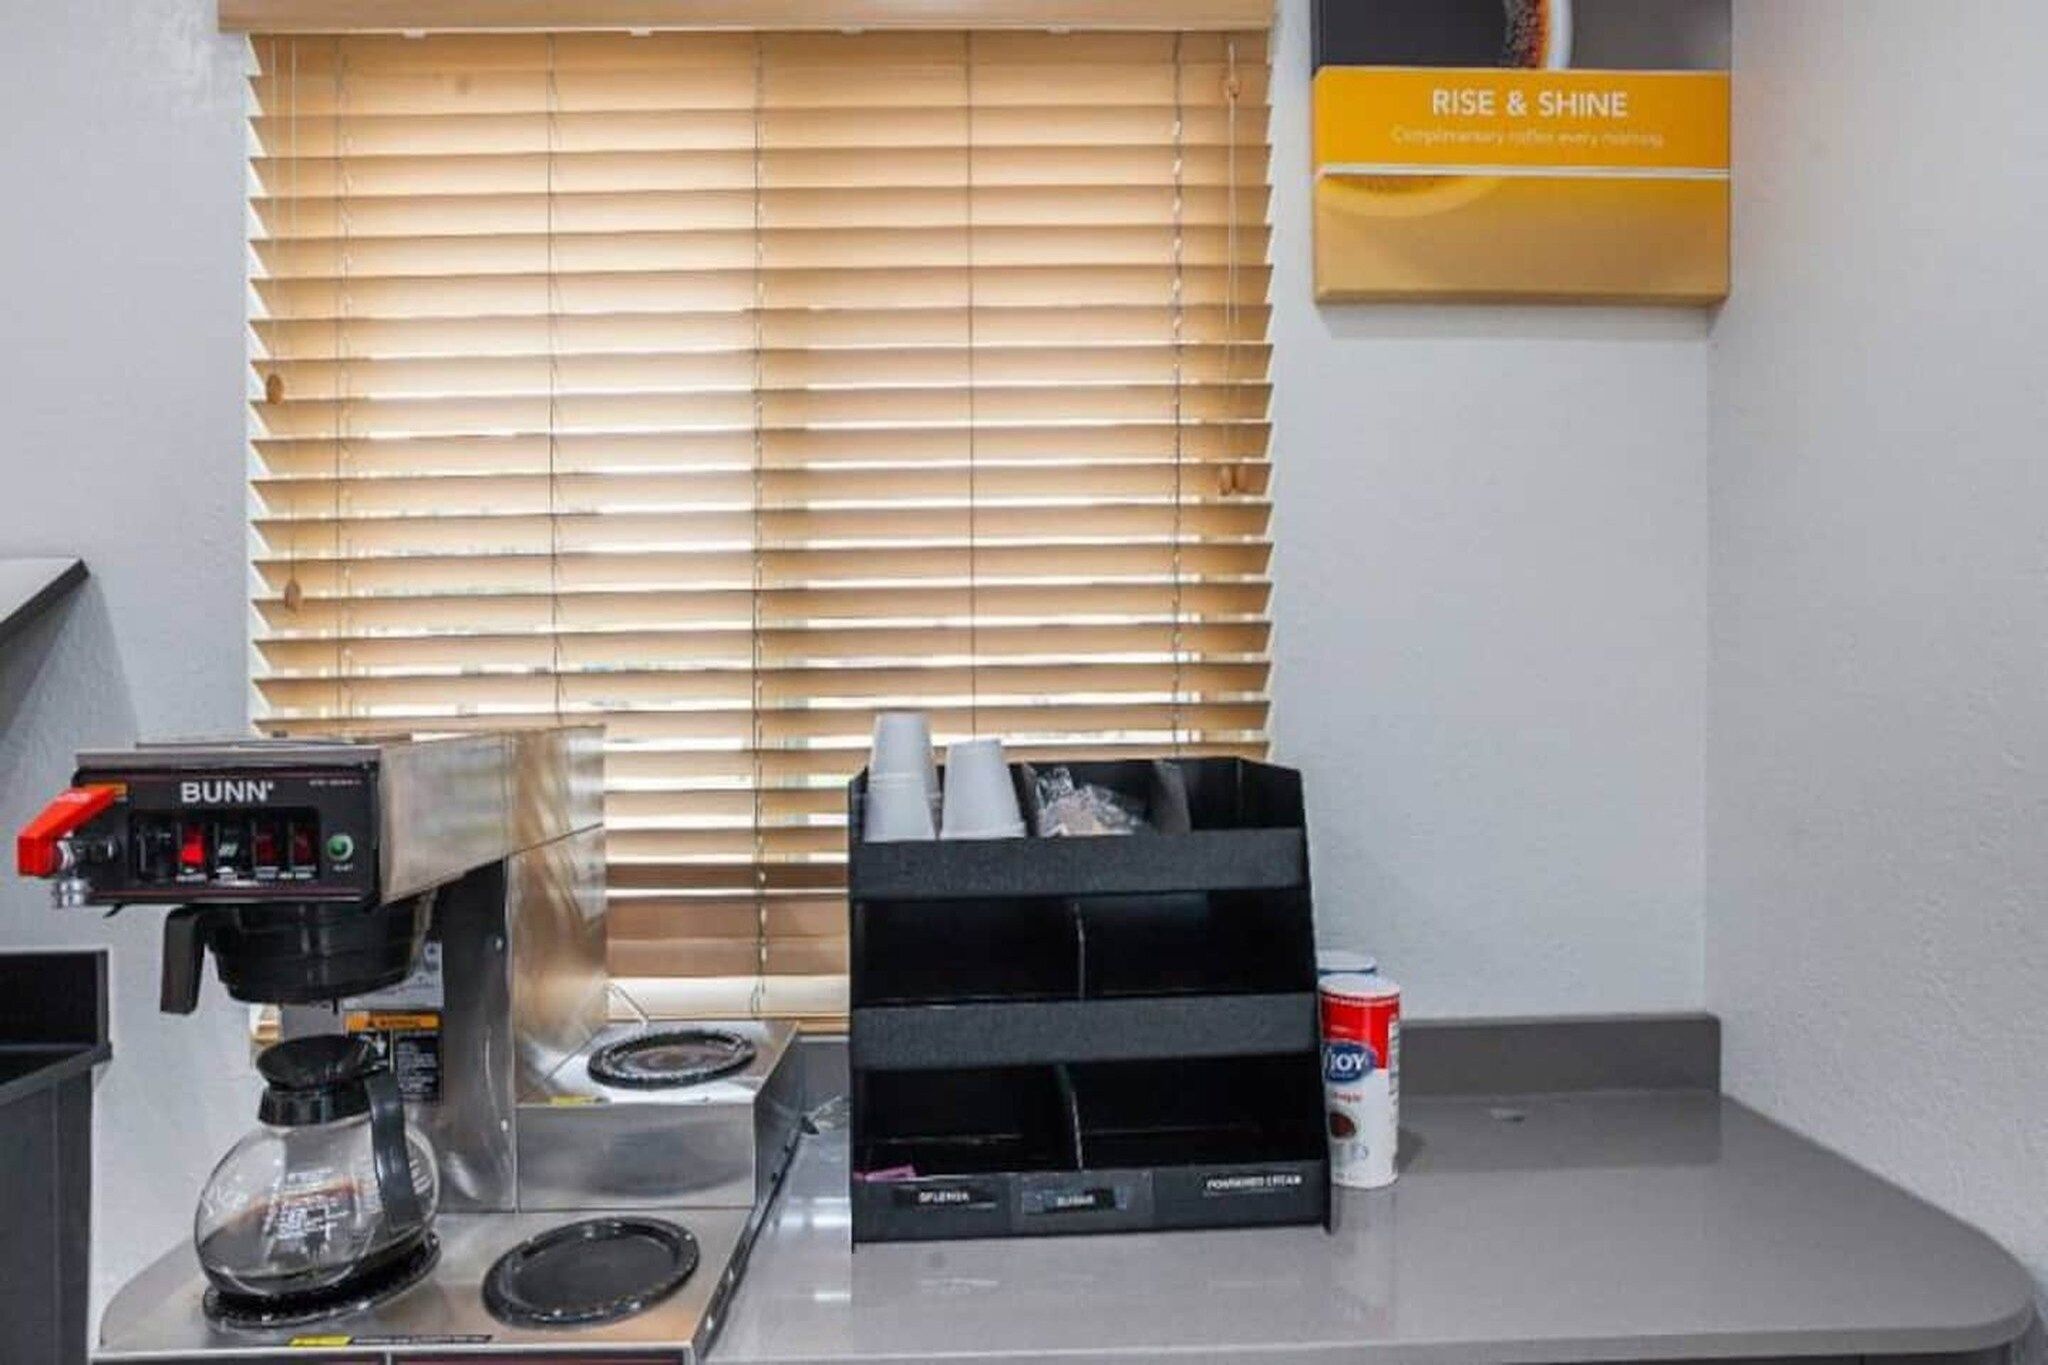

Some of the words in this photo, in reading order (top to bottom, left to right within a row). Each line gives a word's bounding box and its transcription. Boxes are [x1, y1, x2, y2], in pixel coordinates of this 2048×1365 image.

[1432, 88, 1496, 117] RISE
[1507, 89, 1528, 118] &
[1539, 90, 1629, 119] SHINE
[181, 780, 271, 804] BUNN
